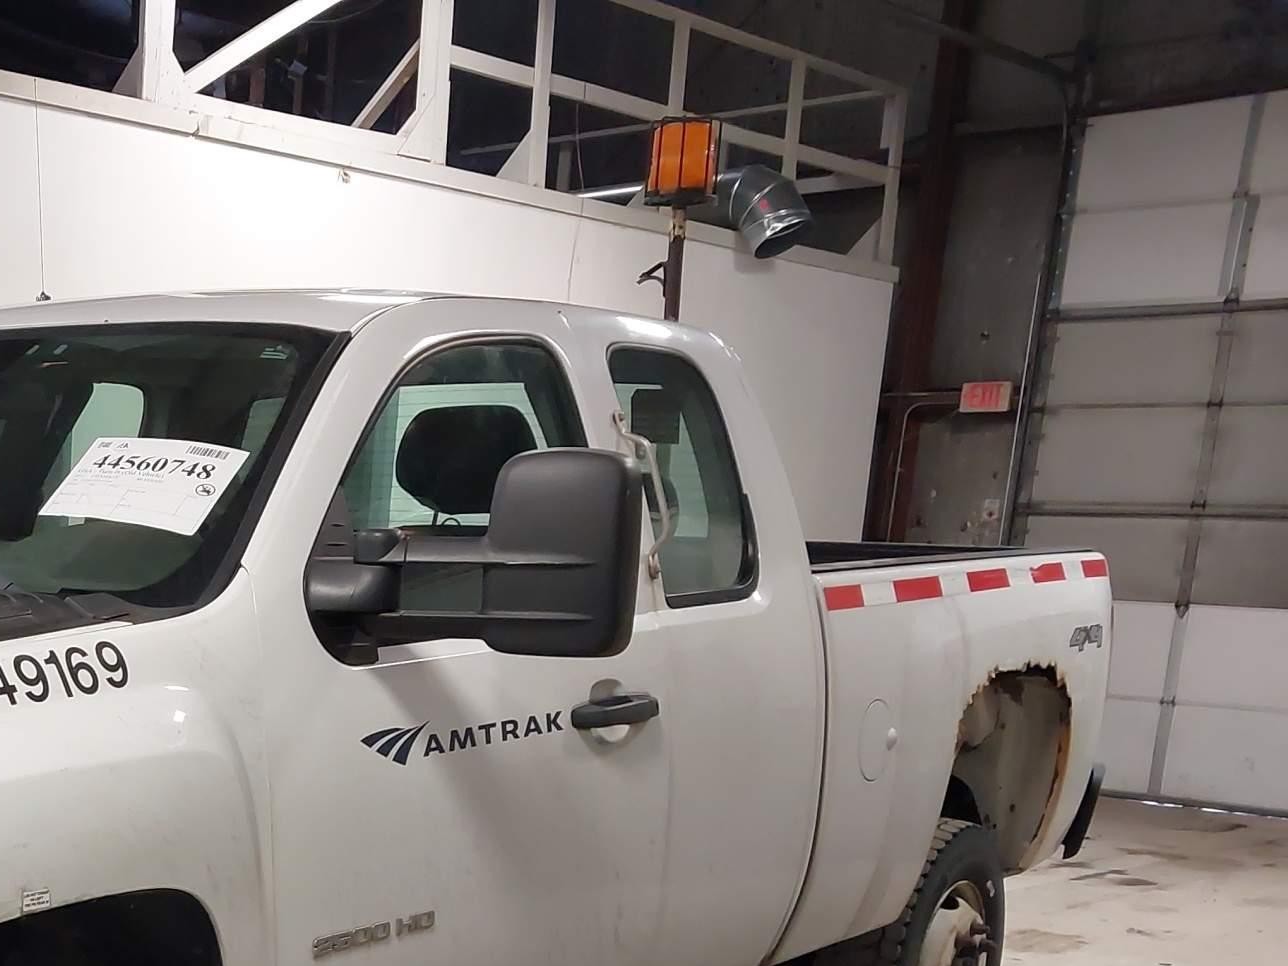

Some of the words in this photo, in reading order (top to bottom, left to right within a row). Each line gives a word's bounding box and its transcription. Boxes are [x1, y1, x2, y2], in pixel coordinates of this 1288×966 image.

[92, 454, 216, 480] 44560748
[423, 710, 564, 758] AMTRAK
[395, 909, 435, 937] HD
